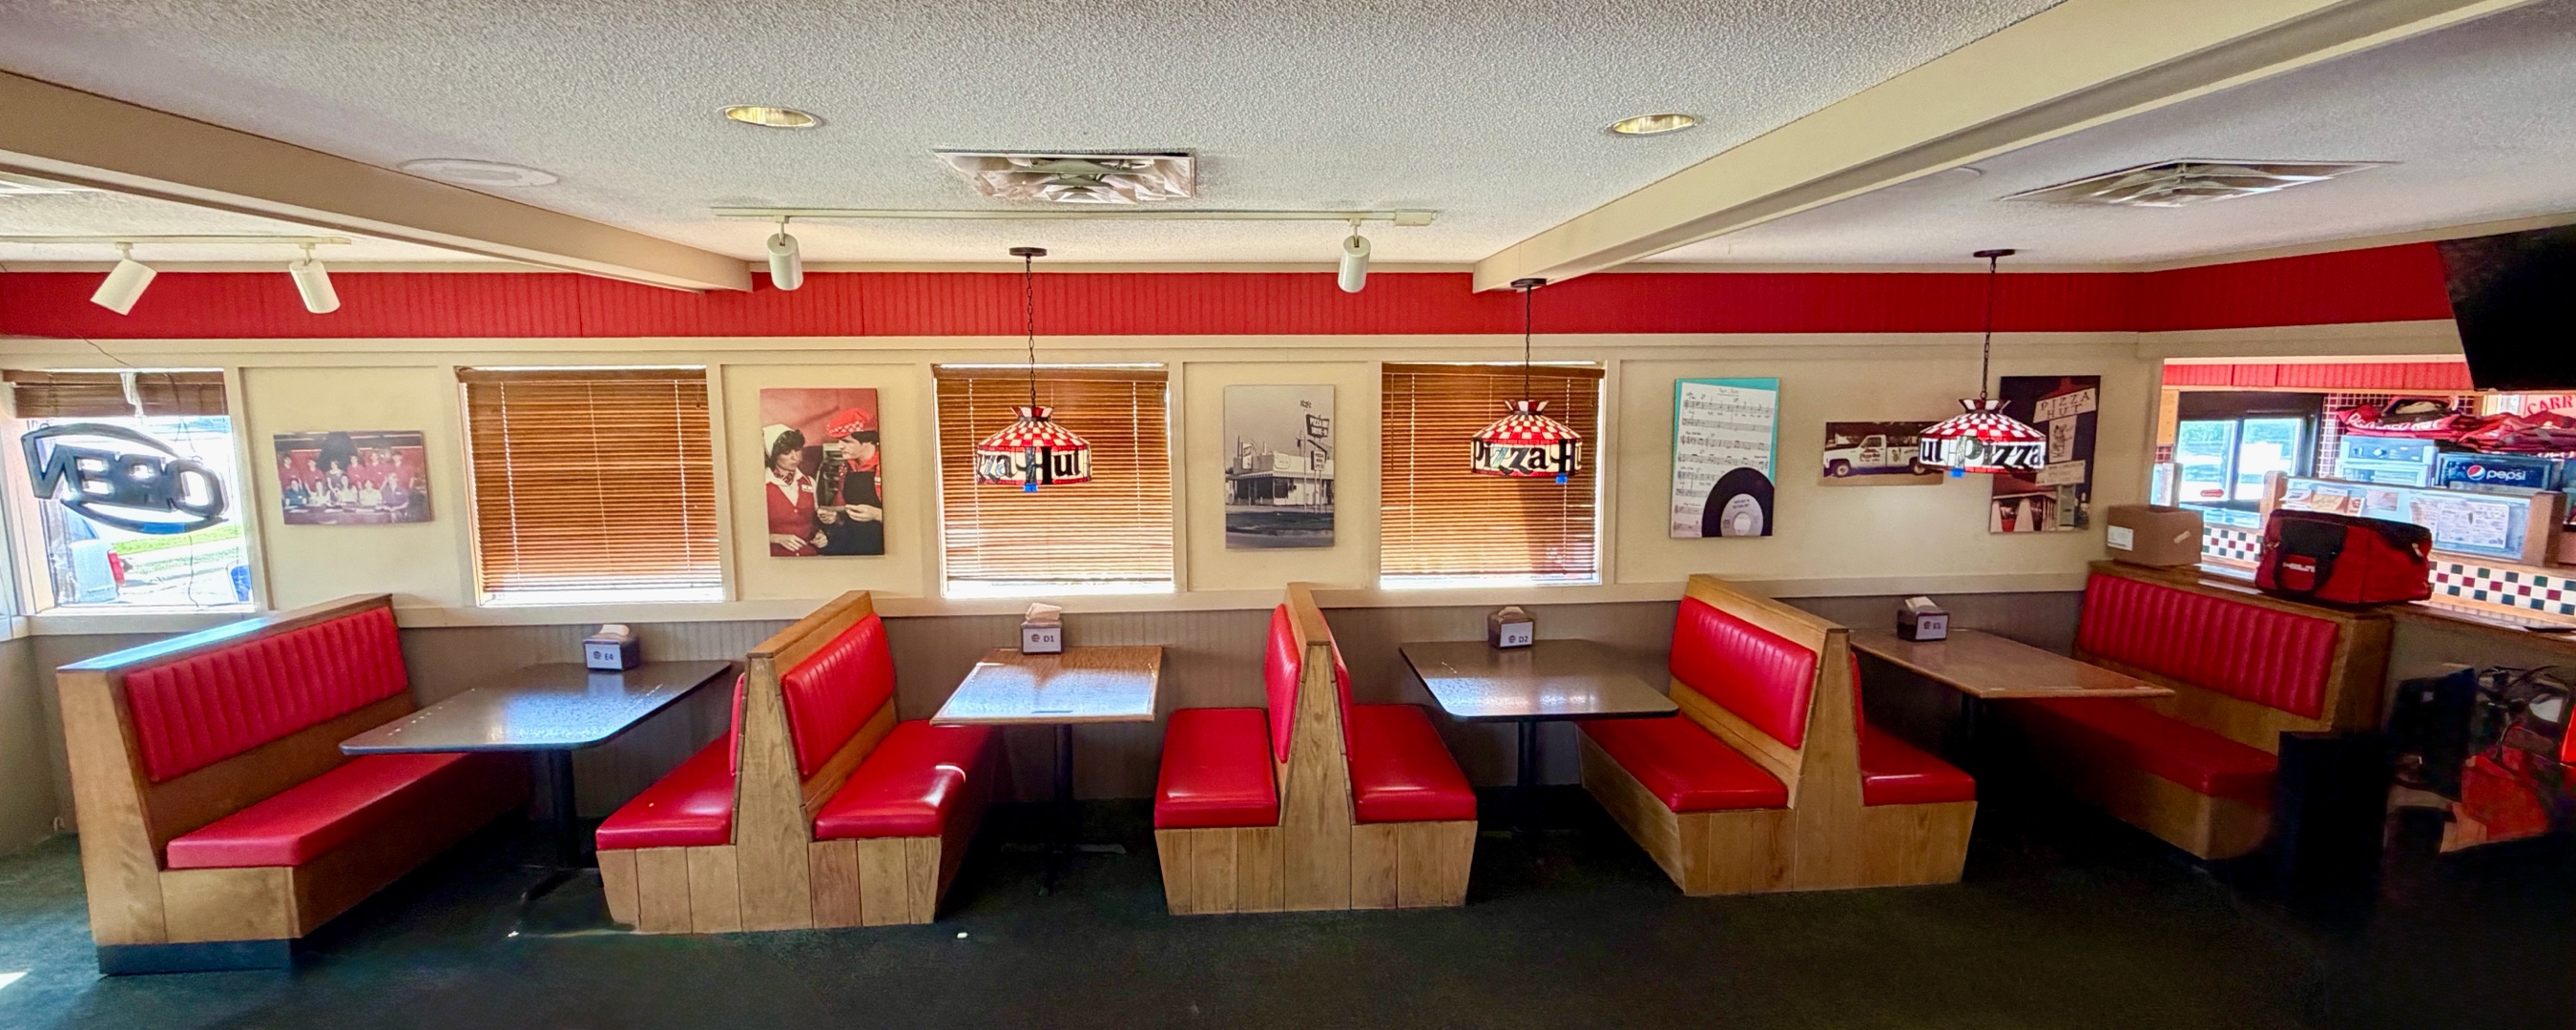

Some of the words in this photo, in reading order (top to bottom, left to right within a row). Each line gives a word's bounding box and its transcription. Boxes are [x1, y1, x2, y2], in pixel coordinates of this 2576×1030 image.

[2041, 391, 2089, 411] PIZZA
[2047, 404, 2082, 419] HUT
[1016, 446, 1083, 484] Hut
[1472, 439, 1551, 476] Pizza
[1956, 436, 2043, 471] Pizza
[2486, 469, 2526, 481] pepsi
